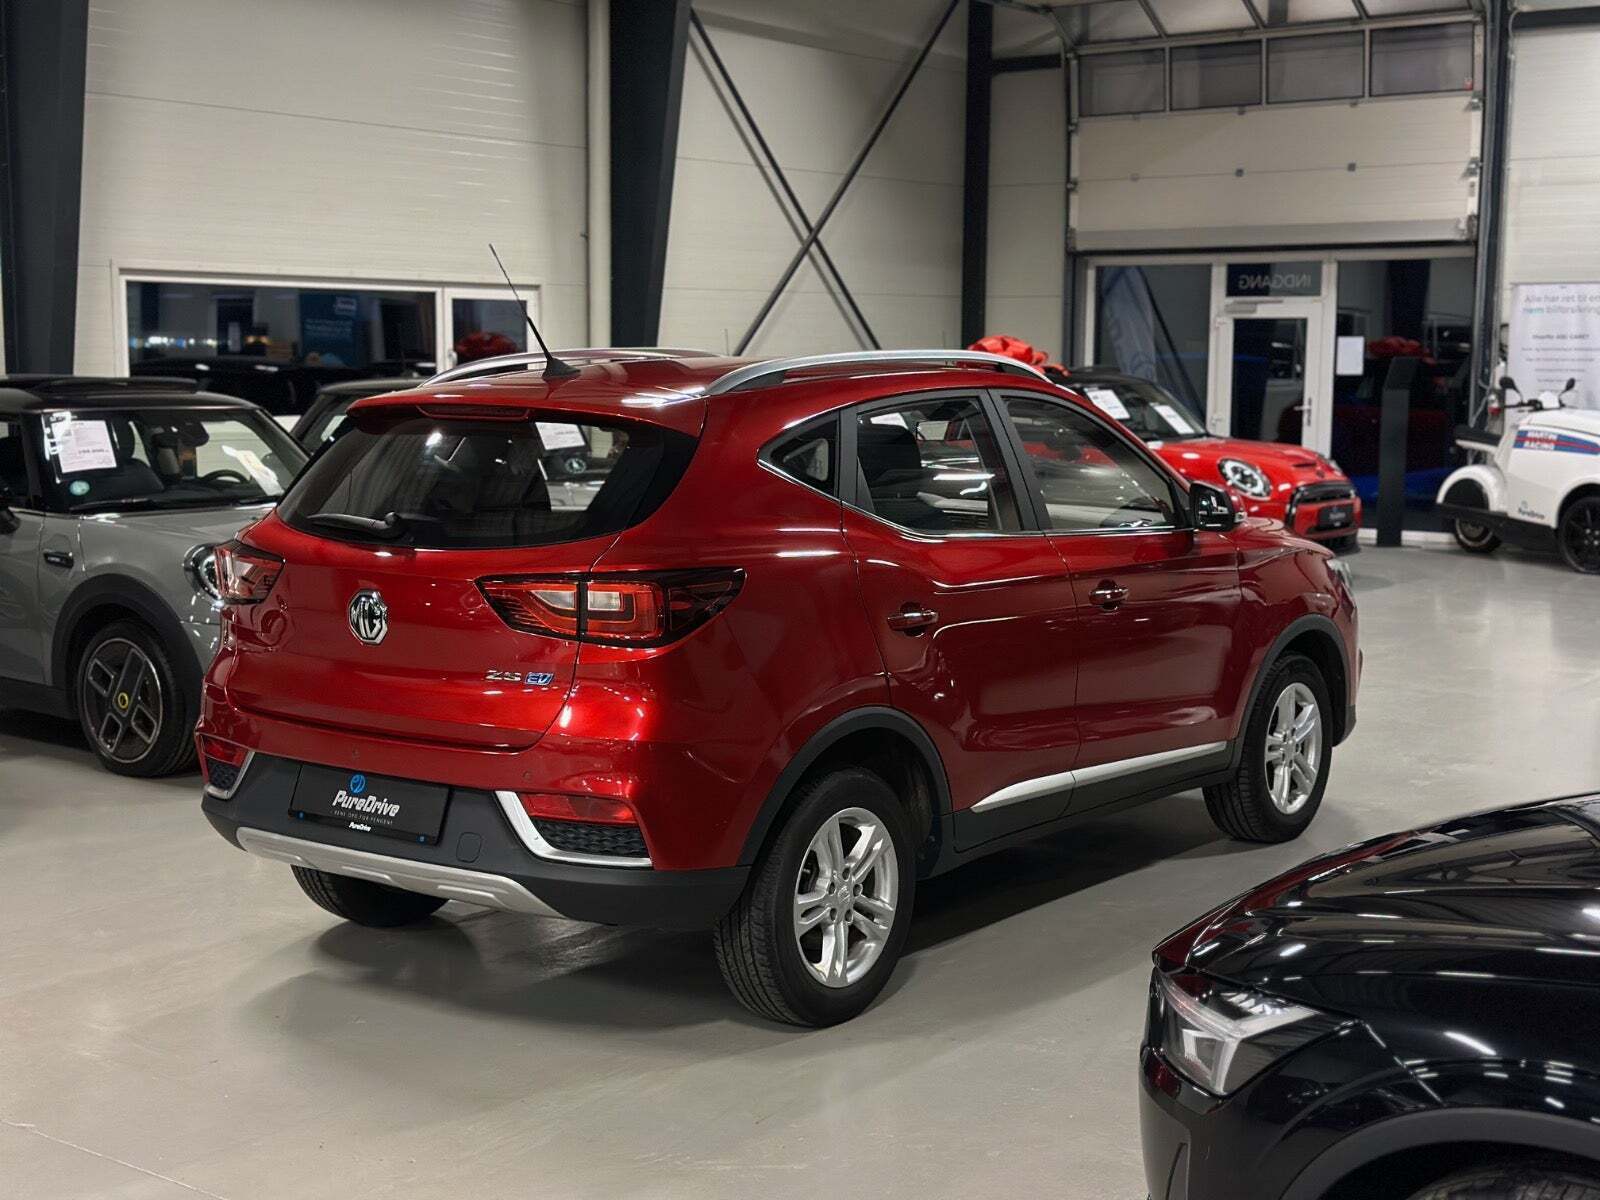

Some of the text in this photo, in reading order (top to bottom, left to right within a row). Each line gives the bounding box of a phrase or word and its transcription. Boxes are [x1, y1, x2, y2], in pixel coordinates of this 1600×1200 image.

[350, 596, 384, 640] MG
[485, 670, 554, 685] ZS EV
[332, 789, 400, 817] PureDrive
